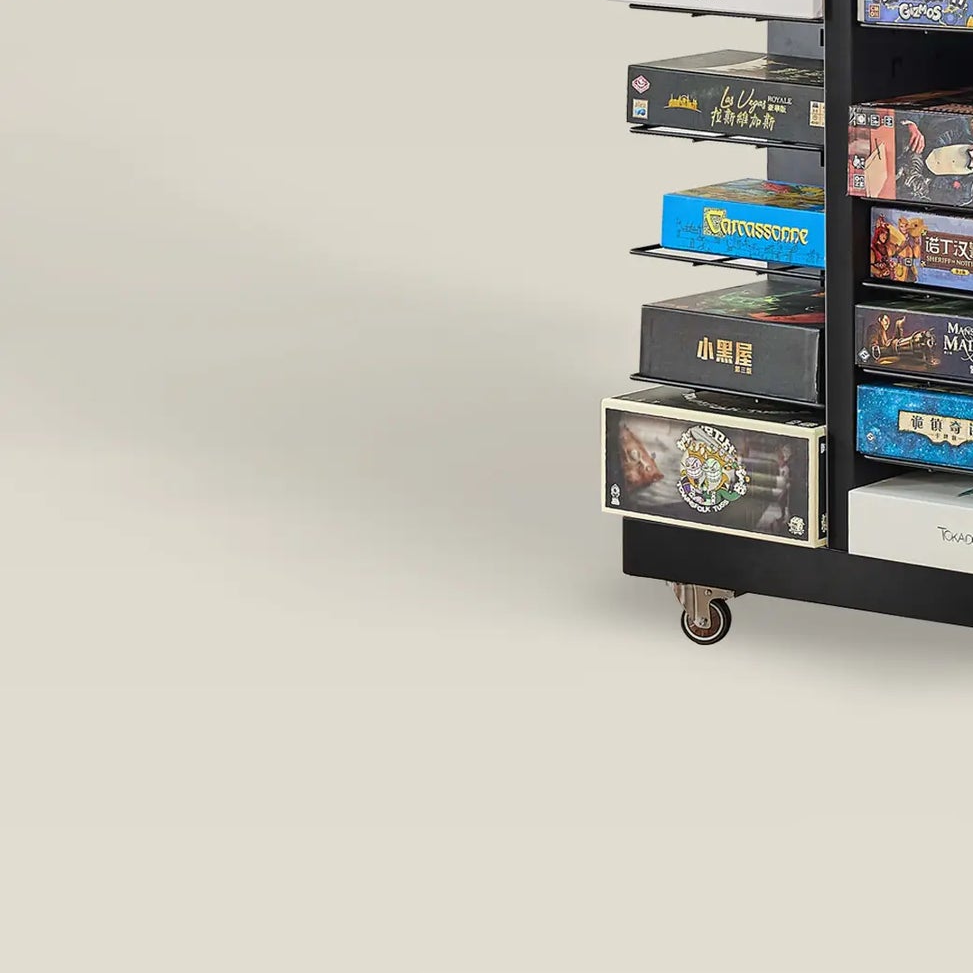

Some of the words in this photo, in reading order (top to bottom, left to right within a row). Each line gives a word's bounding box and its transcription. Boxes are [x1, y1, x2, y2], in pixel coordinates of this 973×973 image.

[720, 86, 734, 108] Las
[737, 88, 767, 113] Vegas
[767, 95, 793, 105] ROYALE
[697, 336, 752, 366] 小黑屋
